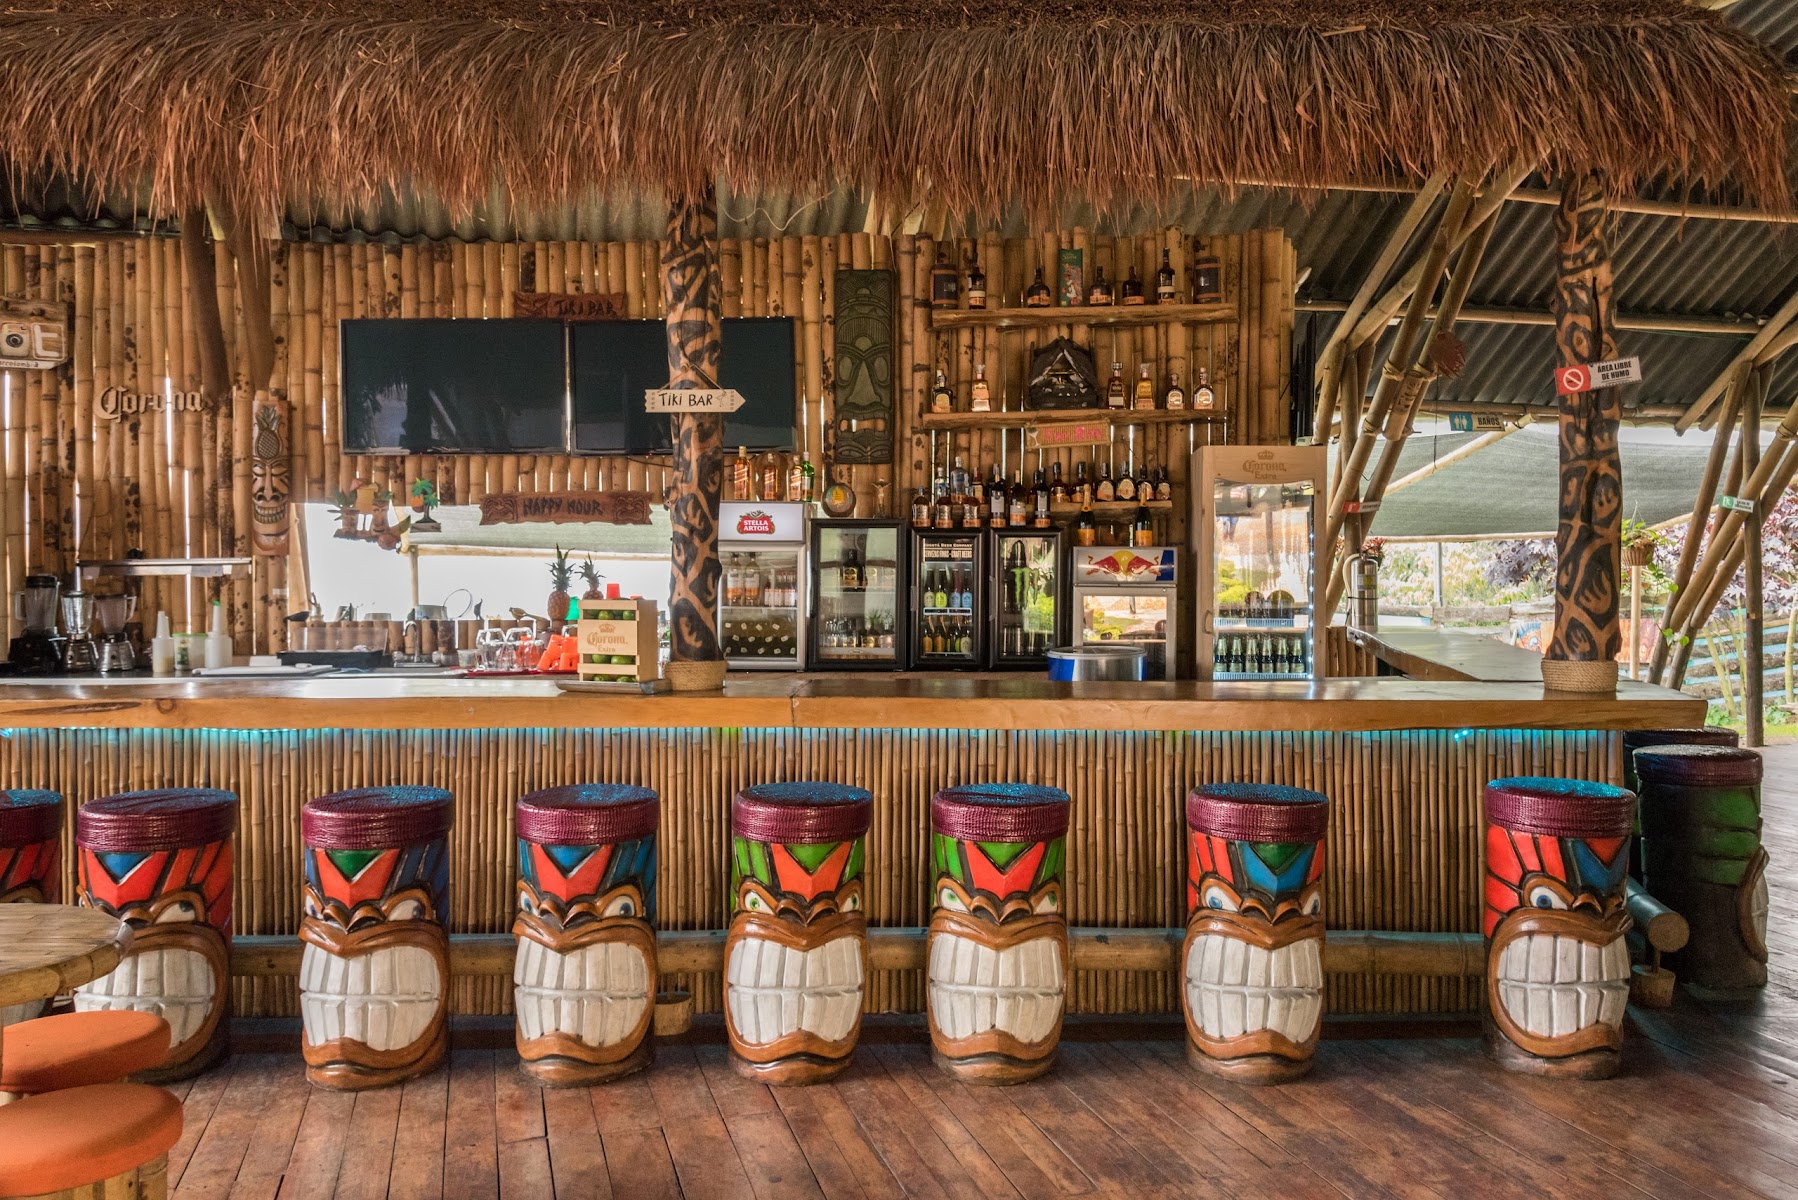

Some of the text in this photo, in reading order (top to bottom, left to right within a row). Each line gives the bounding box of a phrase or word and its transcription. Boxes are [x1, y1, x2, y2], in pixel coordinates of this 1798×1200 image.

[588, 300, 617, 316] BAR
[1614, 361, 1632, 370] LIBRE
[1611, 369, 1630, 378] HUMO
[93, 386, 204, 423] Corona
[688, 393, 713, 407] BAR
[1242, 460, 1287, 473] Corona
[1254, 471, 1277, 480] Extra
[523, 497, 603, 517] HAPPY HOUR
[587, 632, 629, 646] Corona
